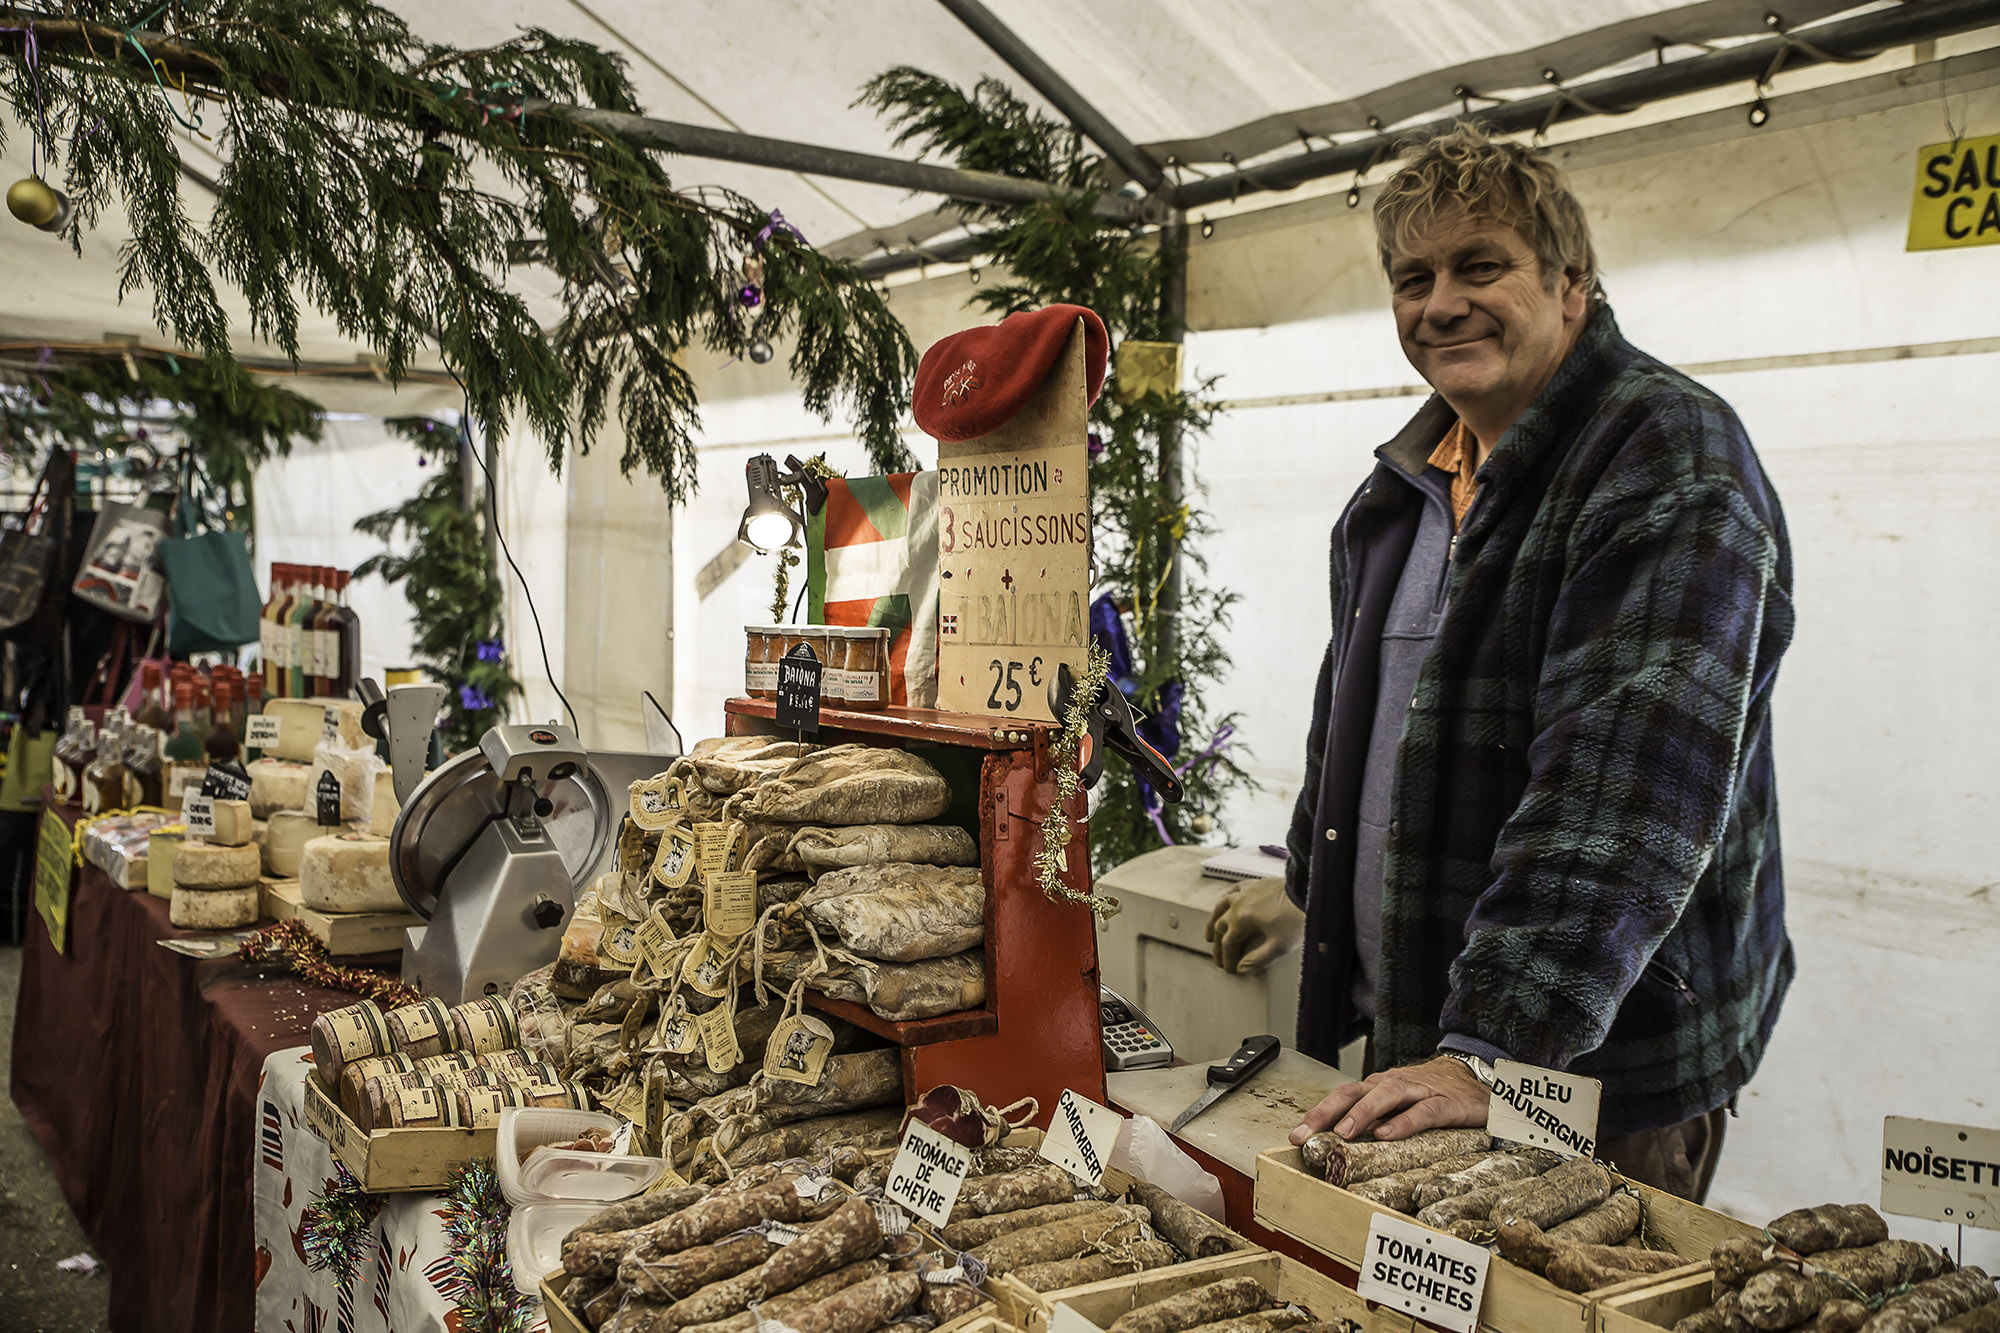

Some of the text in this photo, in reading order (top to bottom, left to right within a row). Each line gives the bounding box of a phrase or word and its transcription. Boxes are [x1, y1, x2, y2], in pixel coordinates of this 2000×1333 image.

[1945, 191, 2000, 240] CA
[939, 456, 1048, 496] PROMOTION
[941, 506, 1087, 553] 3 SAUCISSONS
[784, 664, 816, 687] BAIONA
[1520, 1077, 1572, 1104] BLEU
[1060, 1091, 1103, 1182] CAMEMBERT
[1491, 1078, 1594, 1158] D'AUVERGNE
[905, 1133, 964, 1178] FROMAGE
[915, 1162, 935, 1184] DE
[892, 1175, 946, 1214] CHEVRE
[1376, 1234, 1478, 1286] TOMATES
[1372, 1261, 1474, 1312] SECHEES
